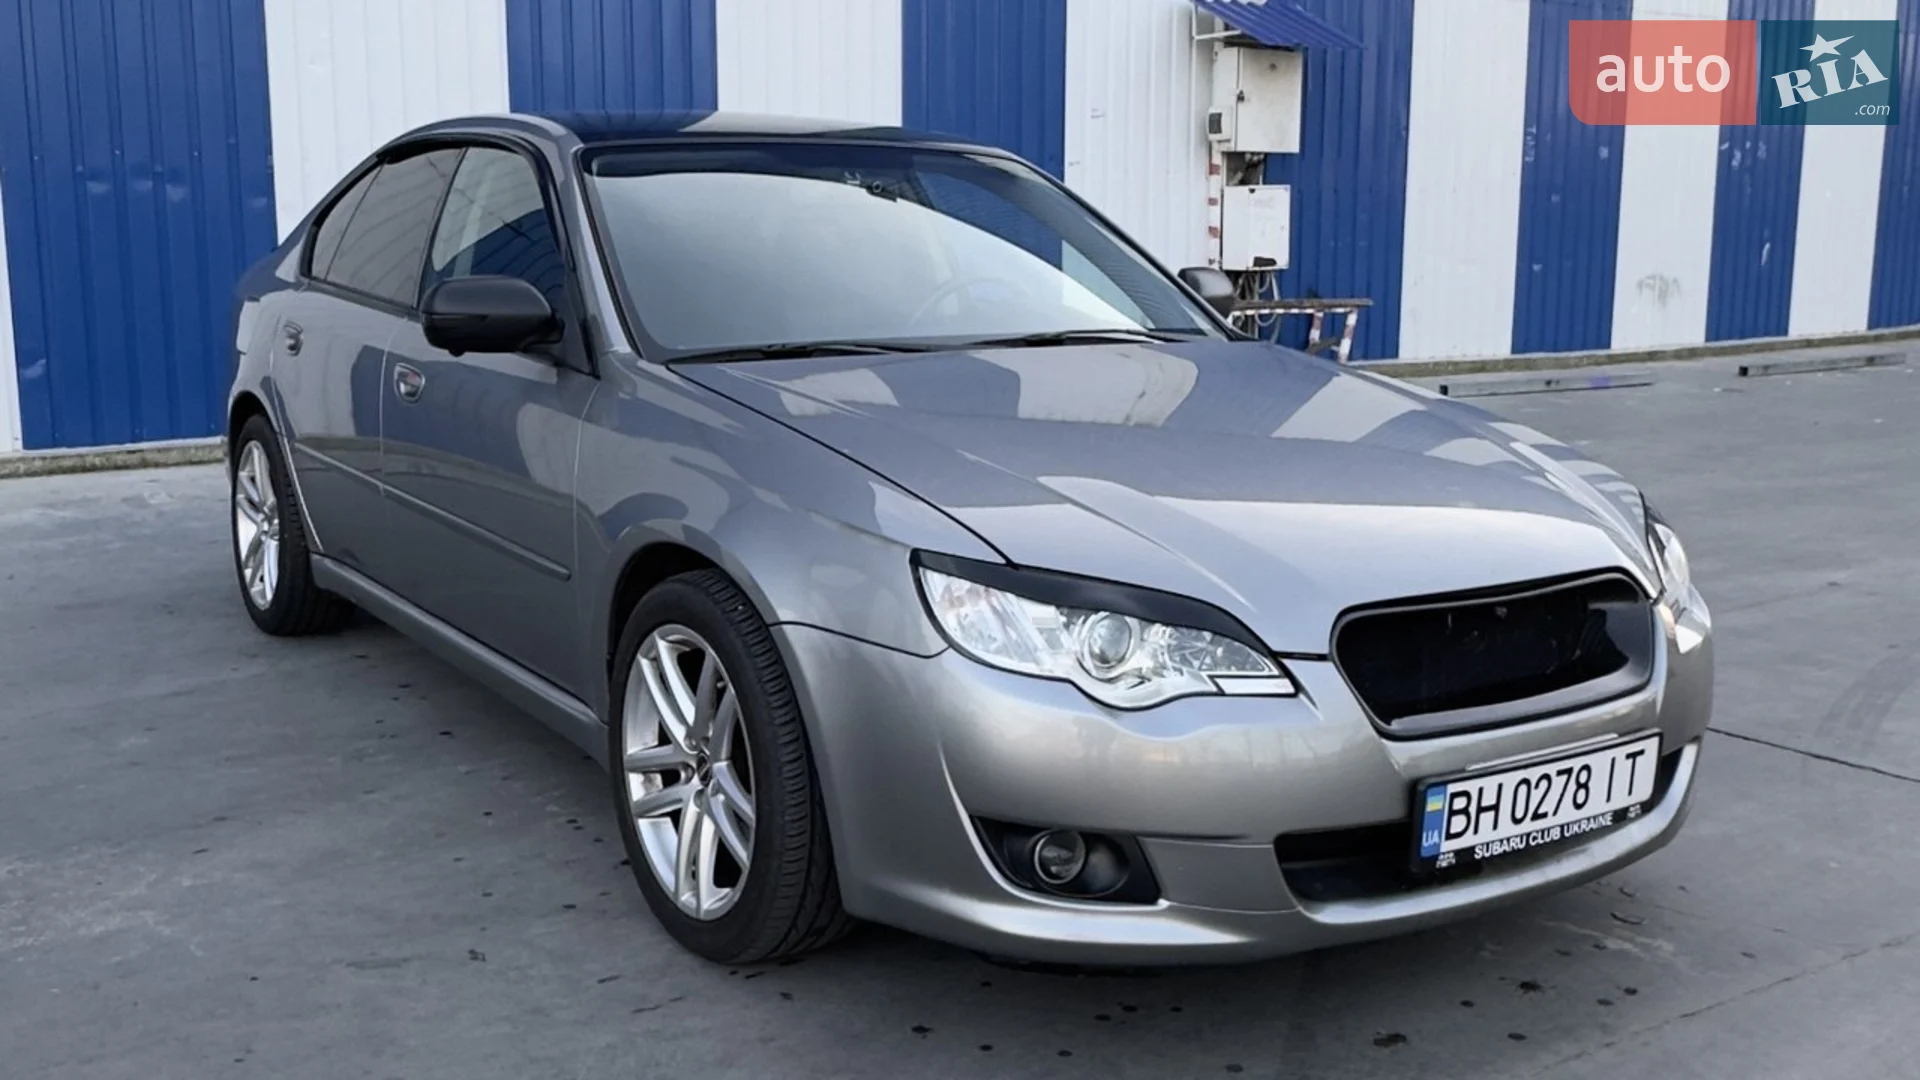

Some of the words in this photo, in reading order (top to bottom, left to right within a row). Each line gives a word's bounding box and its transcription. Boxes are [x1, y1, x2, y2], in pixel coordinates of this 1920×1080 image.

[1445, 783, 1503, 841] BH
[1511, 764, 1592, 825] 0278
[1606, 750, 1645, 802] IT
[1421, 829, 1441, 847] UA
[1474, 835, 1526, 859] SUBARU
[1528, 825, 1561, 847] CLUB
[1563, 812, 1613, 837] UKRAINE
